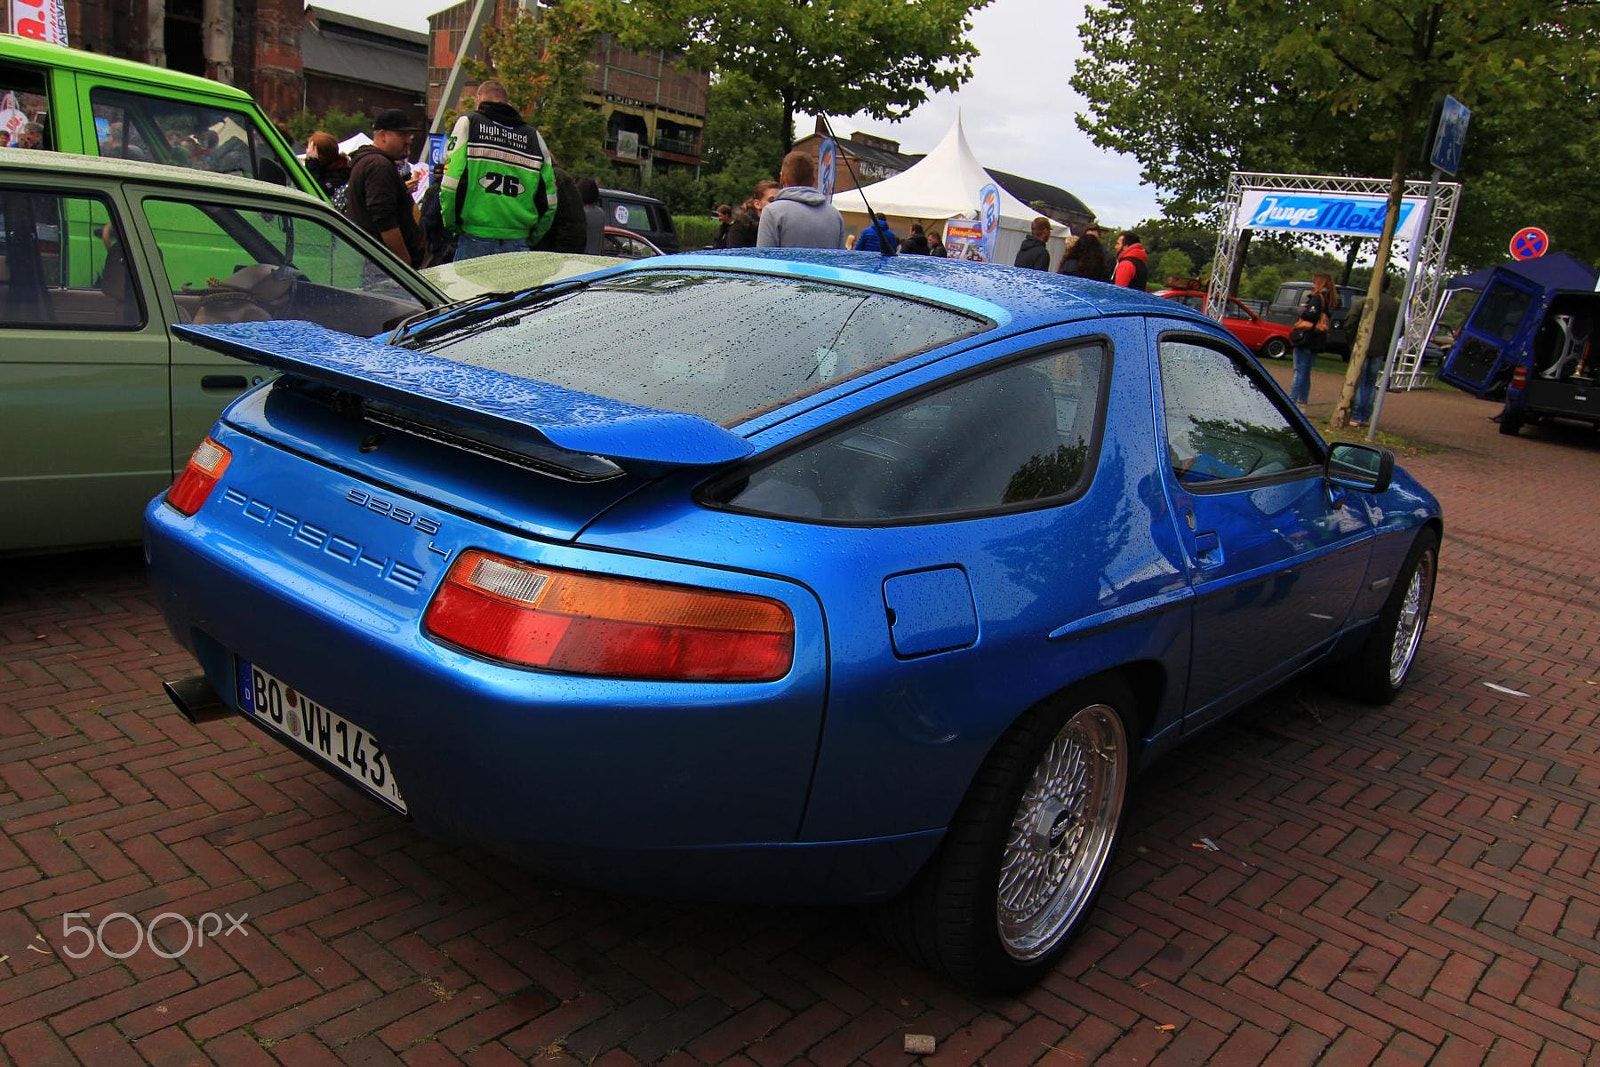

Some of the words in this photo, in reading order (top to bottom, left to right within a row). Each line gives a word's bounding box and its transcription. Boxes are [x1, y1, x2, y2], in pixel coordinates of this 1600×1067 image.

[479, 123, 499, 135] High
[501, 128, 527, 143] Speed
[485, 171, 519, 197] 26
[1256, 198, 1318, 226] Junge
[217, 486, 425, 592] PORSCHE
